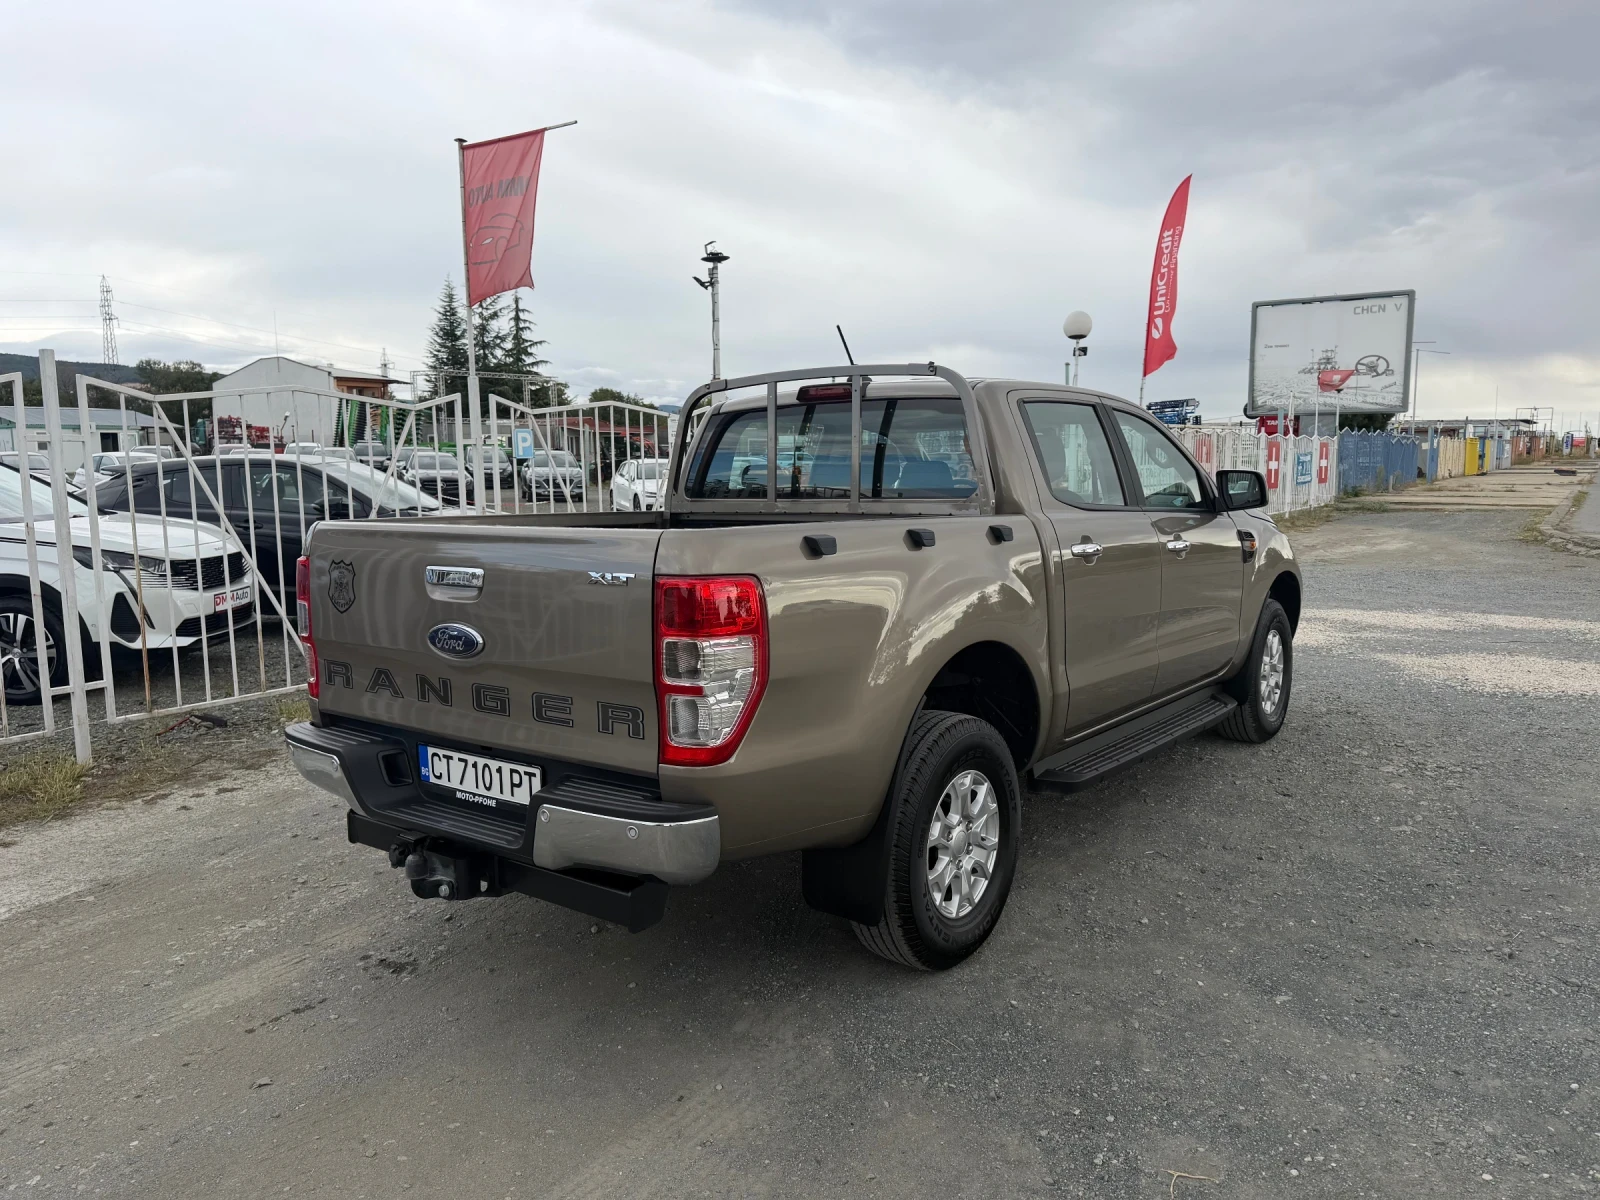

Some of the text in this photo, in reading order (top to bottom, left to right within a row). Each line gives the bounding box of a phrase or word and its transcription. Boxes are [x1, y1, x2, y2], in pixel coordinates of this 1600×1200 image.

[1169, 225, 1182, 268] Financing
[1153, 228, 1174, 315] UniCredit
[517, 432, 531, 456] P
[587, 571, 637, 587] XLT
[435, 628, 466, 651] Ford
[324, 659, 646, 740] RANGER
[455, 790, 497, 808] MOTO-PFOHE
